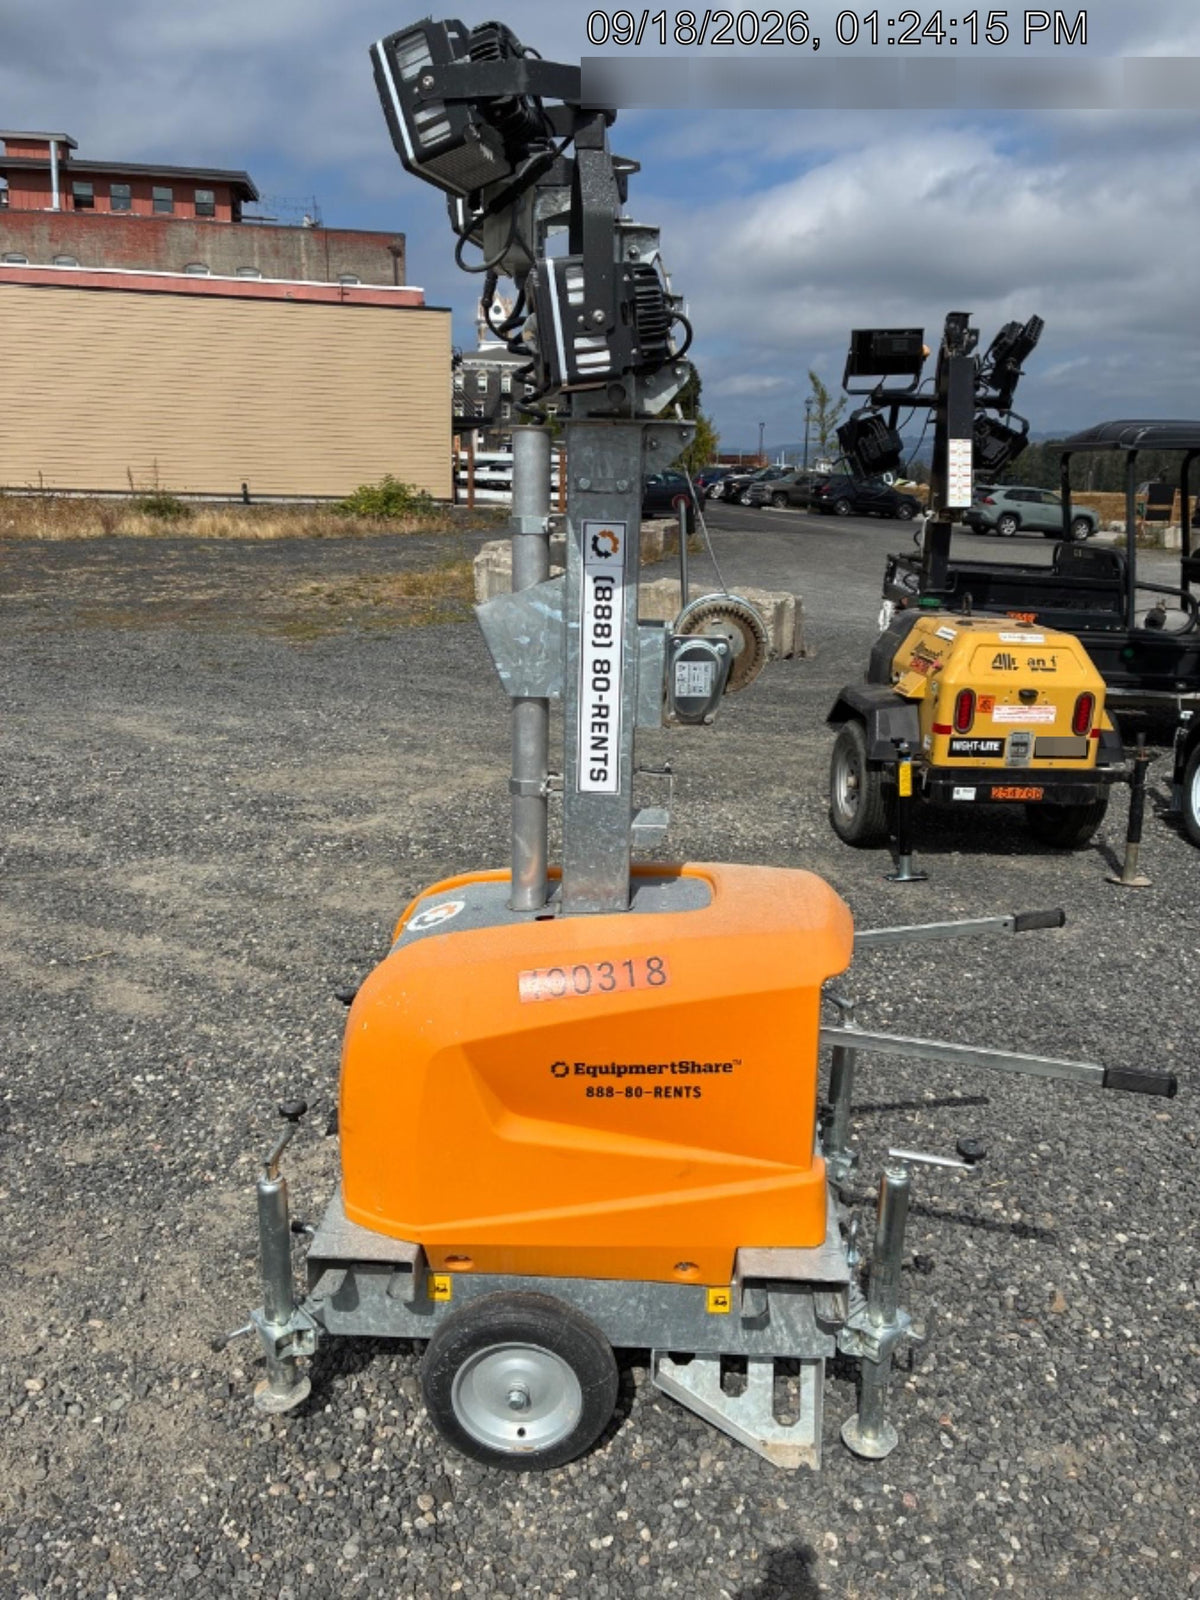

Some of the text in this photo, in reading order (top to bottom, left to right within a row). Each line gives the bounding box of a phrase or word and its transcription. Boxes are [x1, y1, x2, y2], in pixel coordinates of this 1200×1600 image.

[589, 575, 615, 782] (888) 80-RENTS
[586, 1085, 702, 1098] 888-80-RENTS
